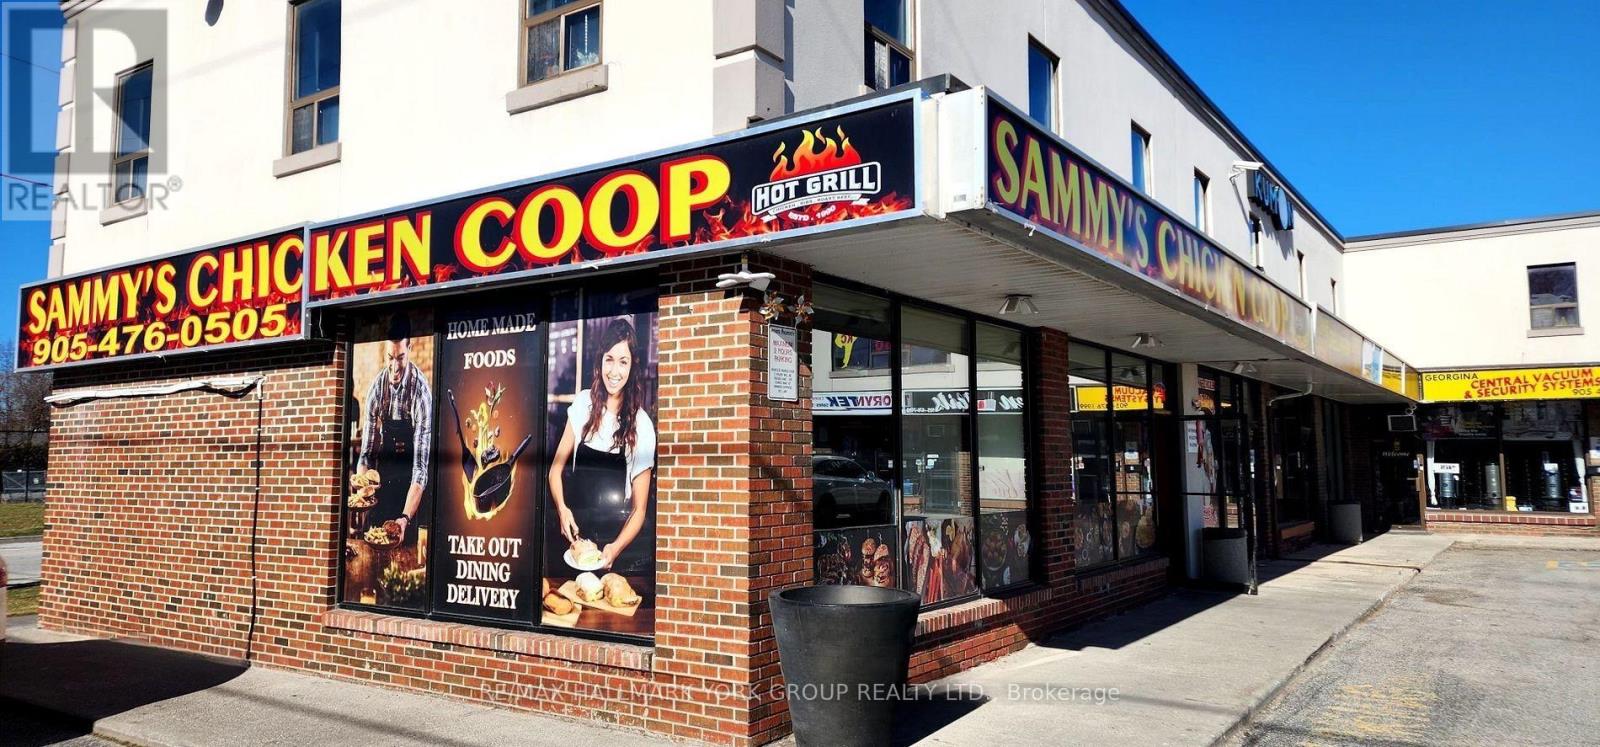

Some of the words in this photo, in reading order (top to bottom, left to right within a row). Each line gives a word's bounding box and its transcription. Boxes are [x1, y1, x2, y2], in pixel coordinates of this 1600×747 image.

[756, 181, 800, 211] HOT
[806, 166, 877, 196] GRILL
[992, 119, 1150, 269] SAMMY'S
[1254, 171, 1294, 230] KUMON
[28, 263, 177, 335] SAMMY'S
[187, 211, 433, 308] CHICKEN
[455, 156, 732, 273] COOP
[33, 303, 288, 365] 905-476-0505
[446, 318, 490, 341] HOME
[491, 312, 537, 334] MADE
[463, 348, 517, 370] FOODS
[1424, 372, 1479, 382] GEORGINA
[1463, 390, 1473, 400] &
[1476, 384, 1538, 398] SECURITY
[1542, 376, 1600, 392] SYSTEMS
[1470, 375, 1530, 389] CENTRAL
[1533, 368, 1594, 383] VACUUM
[1572, 388, 1592, 397] 905
[448, 535, 486, 557] TAKE
[488, 536, 522, 559] OUT
[455, 559, 511, 582] DINING
[446, 583, 521, 610] DELIVERY
